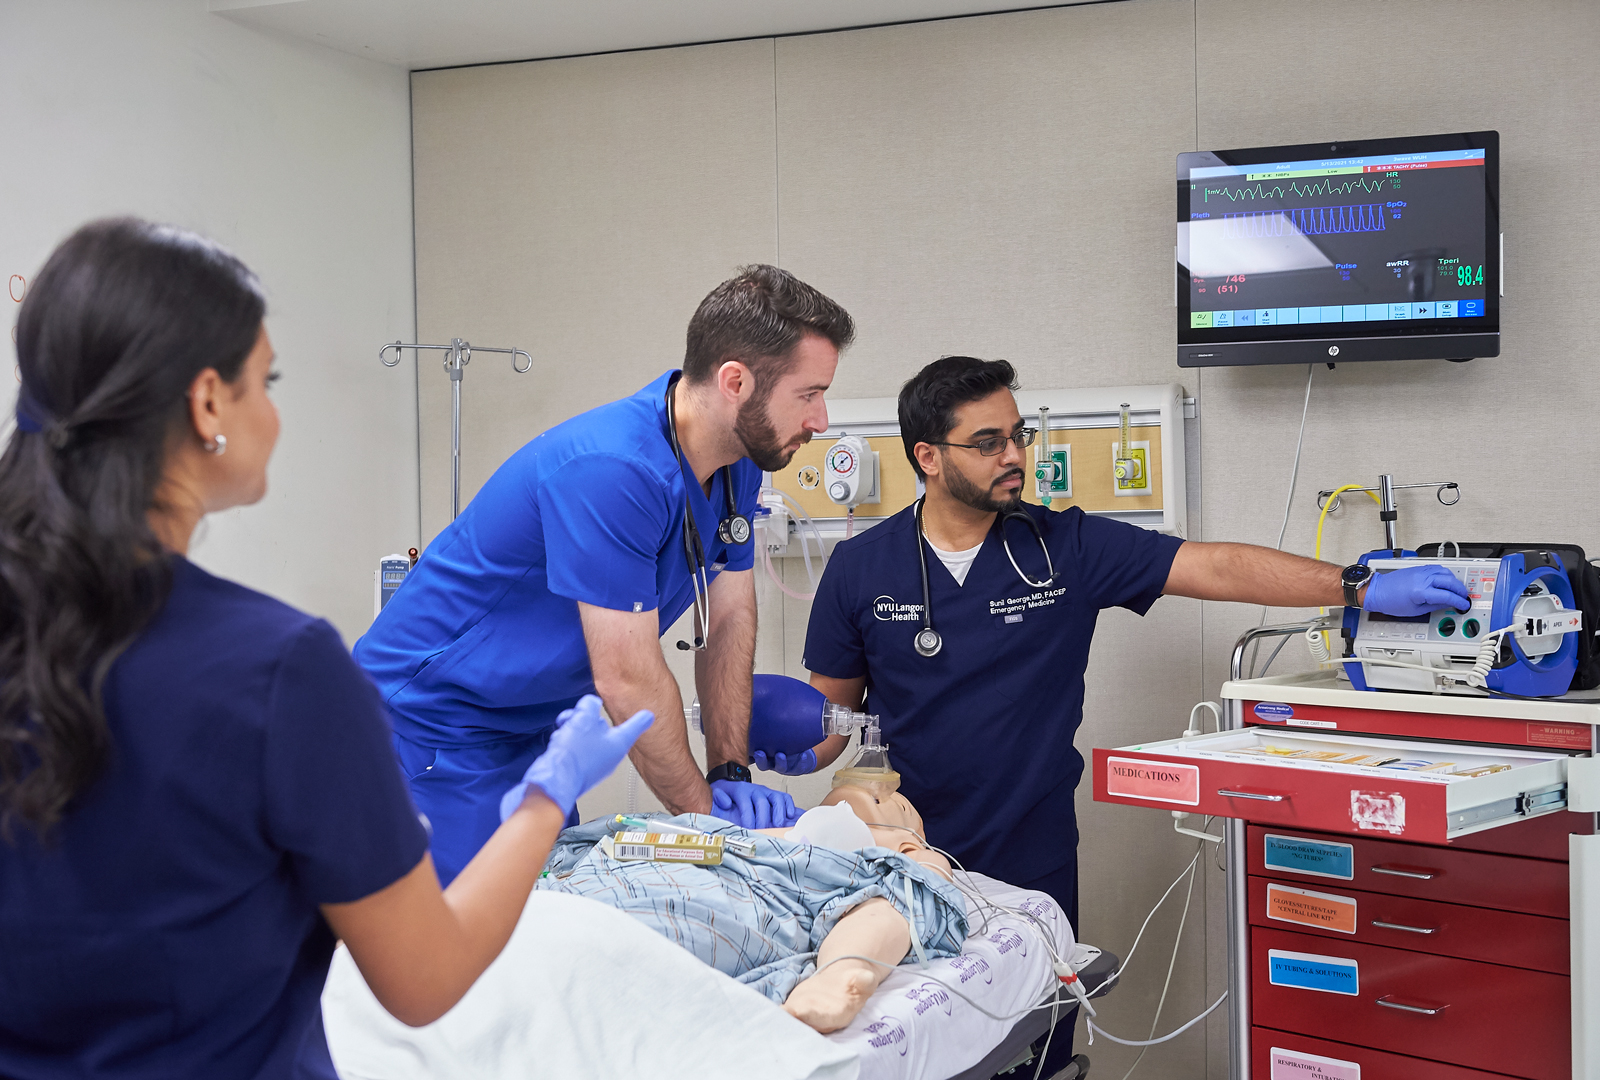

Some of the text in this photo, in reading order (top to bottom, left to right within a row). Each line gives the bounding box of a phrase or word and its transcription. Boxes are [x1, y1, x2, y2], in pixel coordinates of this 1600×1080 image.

[1226, 274, 1246, 283] /46
[1458, 265, 1483, 286] 98.4
[1218, 285, 1238, 294] (51)
[1044, 588, 1066, 598] FACEP
[877, 603, 924, 613] NYU Langon
[990, 599, 1055, 614] Emergency Medicine
[892, 612, 919, 621] Health
[1113, 766, 1180, 783] MEDICATIONS
[1284, 965, 1308, 974] TUBING
[1315, 969, 1352, 979] SOLUTIONS
[1278, 1059, 1317, 1071] RESPIRATORY
